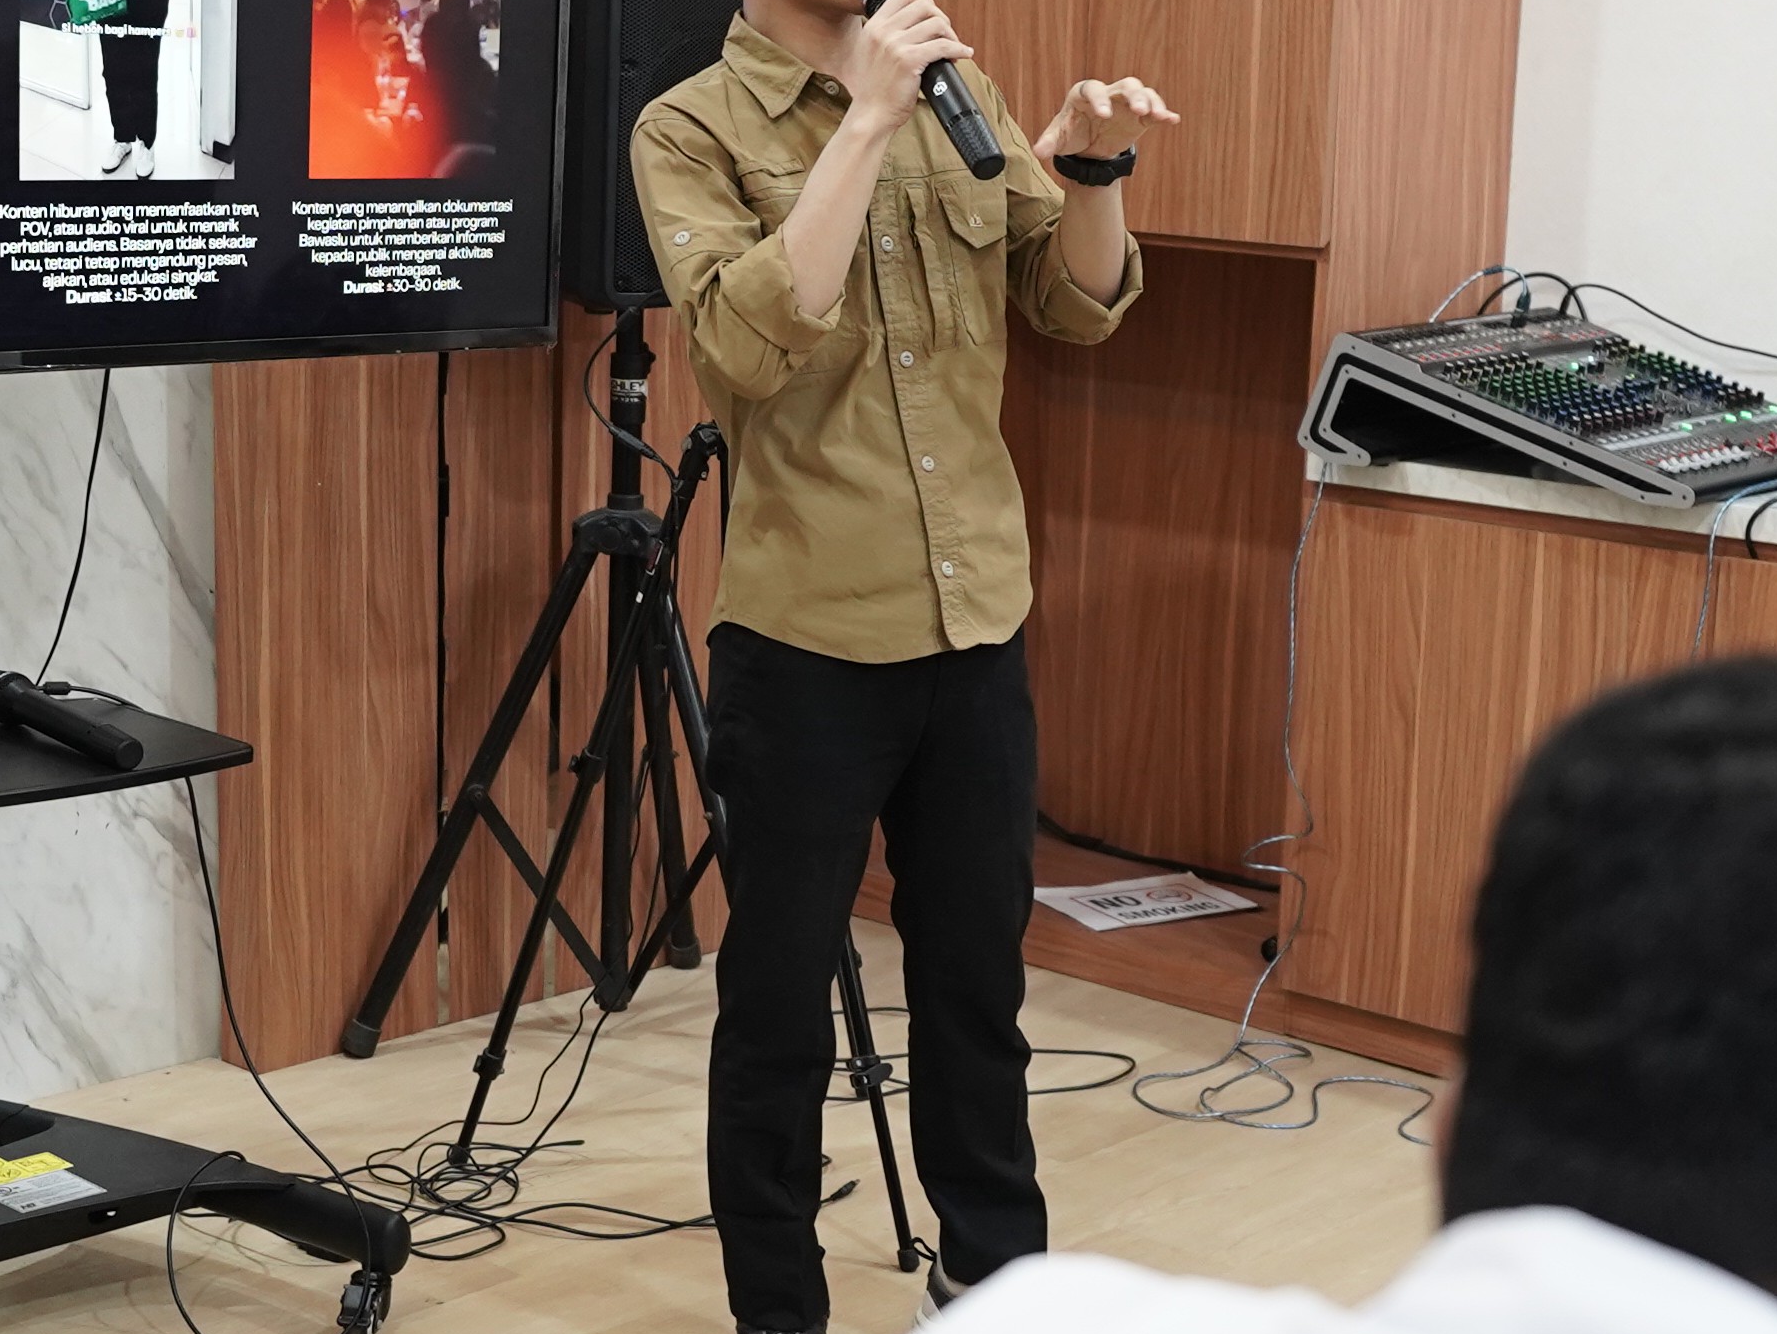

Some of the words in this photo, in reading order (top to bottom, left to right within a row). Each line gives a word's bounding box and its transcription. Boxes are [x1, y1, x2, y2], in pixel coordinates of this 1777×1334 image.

[0, 204, 49, 219] Konten
[50, 203, 99, 218] hiburan
[101, 205, 133, 221] yang
[136, 202, 231, 217] memanfaatkan
[292, 201, 334, 215] Konten
[336, 203, 365, 217] yang
[366, 199, 441, 216] menampilkan
[443, 199, 513, 213] dokumentasi
[54, 223, 83, 236] atau
[85, 220, 121, 235] audio
[123, 220, 149, 235] viral
[151, 220, 188, 234] untuk
[190, 218, 239, 233] menarik
[307, 217, 357, 234] kegiatan
[426, 218, 450, 229] atau
[452, 216, 498, 231] program
[0, 238, 64, 258] perhatian
[175, 235, 207, 250] tidak
[209, 235, 257, 249] sekadar
[299, 233, 348, 247] Bawaslu
[350, 232, 383, 246] untuk
[385, 231, 454, 245] memberikan
[456, 230, 505, 243] informasi
[45, 256, 83, 273] tetapi
[85, 256, 120, 272] tetap
[122, 252, 206, 270] mengandung
[311, 249, 354, 265] kepada
[356, 248, 390, 264] publik
[392, 247, 447, 262] mengenai
[448, 246, 494, 259] aktivitas
[89, 273, 118, 287] atau
[120, 271, 169, 285] edukasi
[1089, 896, 1142, 909] NO
[1118, 901, 1220, 919] SMOKING
